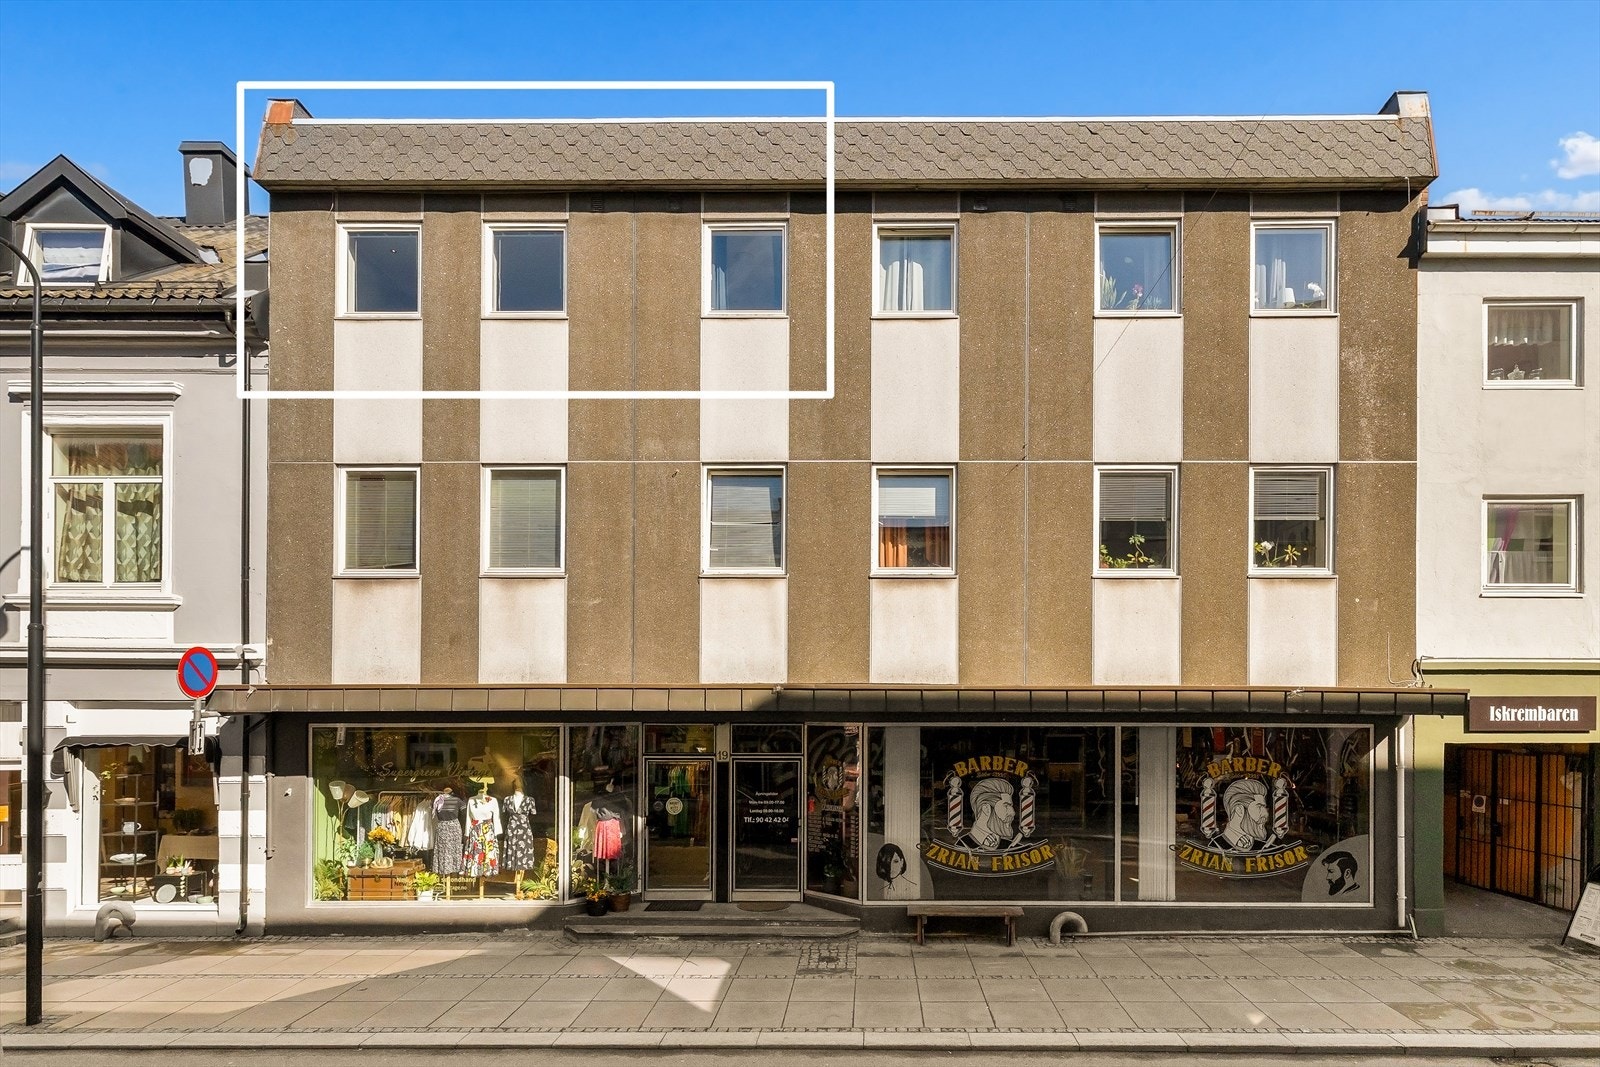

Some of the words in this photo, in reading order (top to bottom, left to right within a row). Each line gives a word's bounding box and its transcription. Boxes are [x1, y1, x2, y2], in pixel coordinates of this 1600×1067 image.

[1489, 705, 1579, 721] Iskrembaren
[717, 750, 729, 760] 19
[953, 755, 1029, 777] BARBER
[379, 761, 441, 782] Supergreen
[1206, 756, 1282, 778] BARBER
[926, 843, 981, 872] ZRIAN
[1178, 843, 1234, 872] ZRIAN
